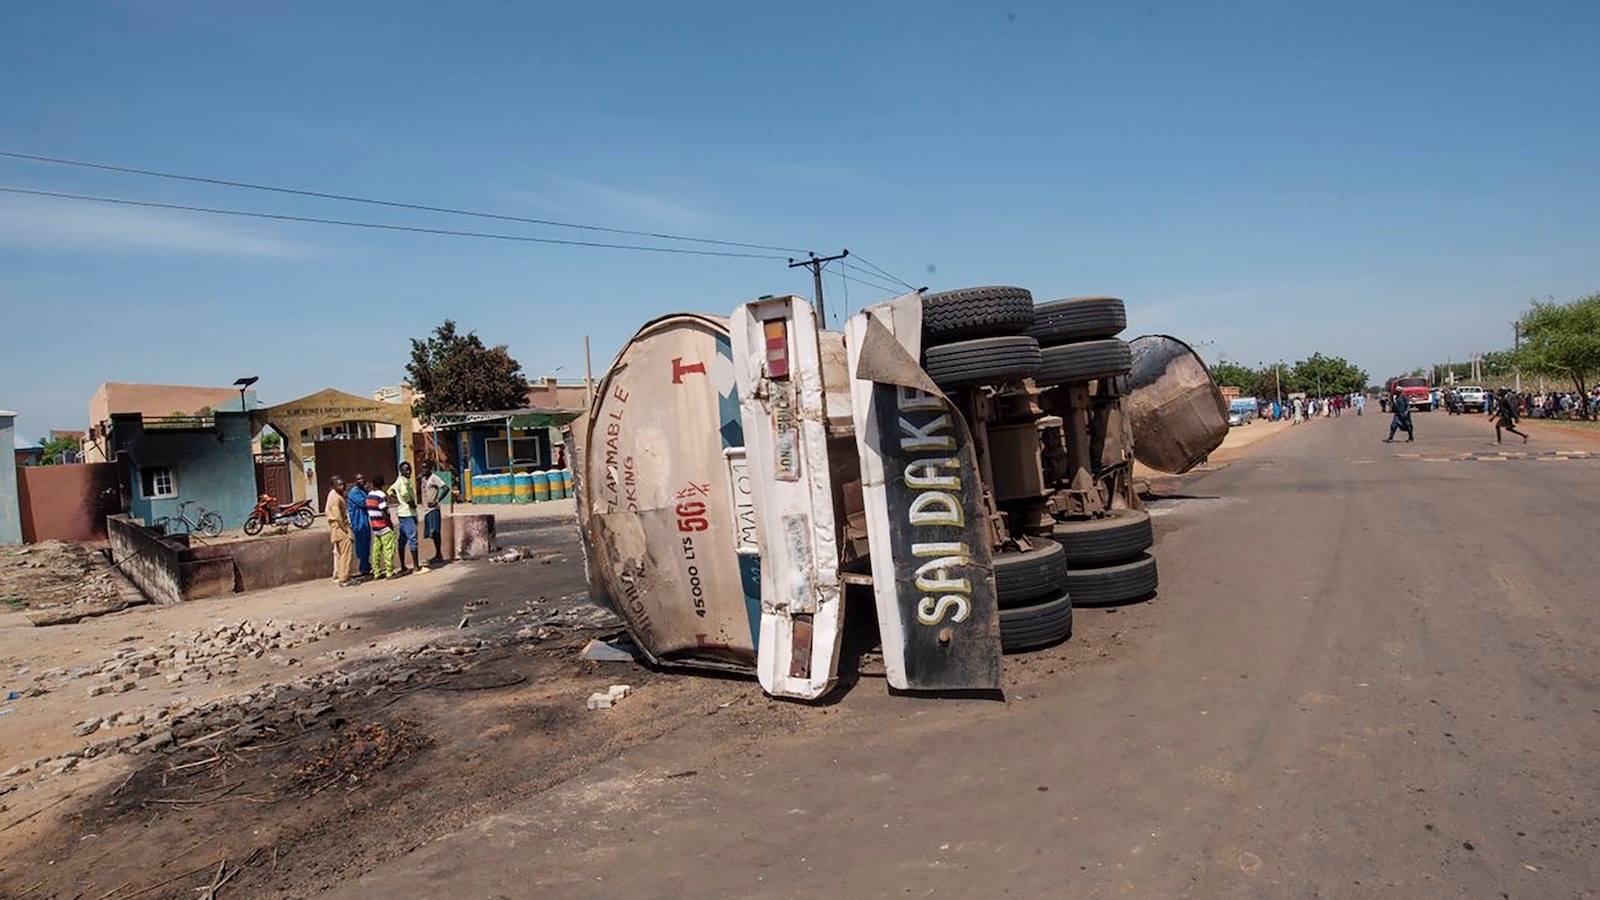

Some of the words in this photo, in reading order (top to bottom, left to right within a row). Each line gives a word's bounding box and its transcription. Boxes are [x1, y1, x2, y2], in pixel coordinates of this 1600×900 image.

[671, 357, 706, 384] T
[676, 501, 708, 533] 56
[682, 537, 695, 560] LTS
[688, 566, 706, 618] 45000
[911, 542, 971, 626] SAI
